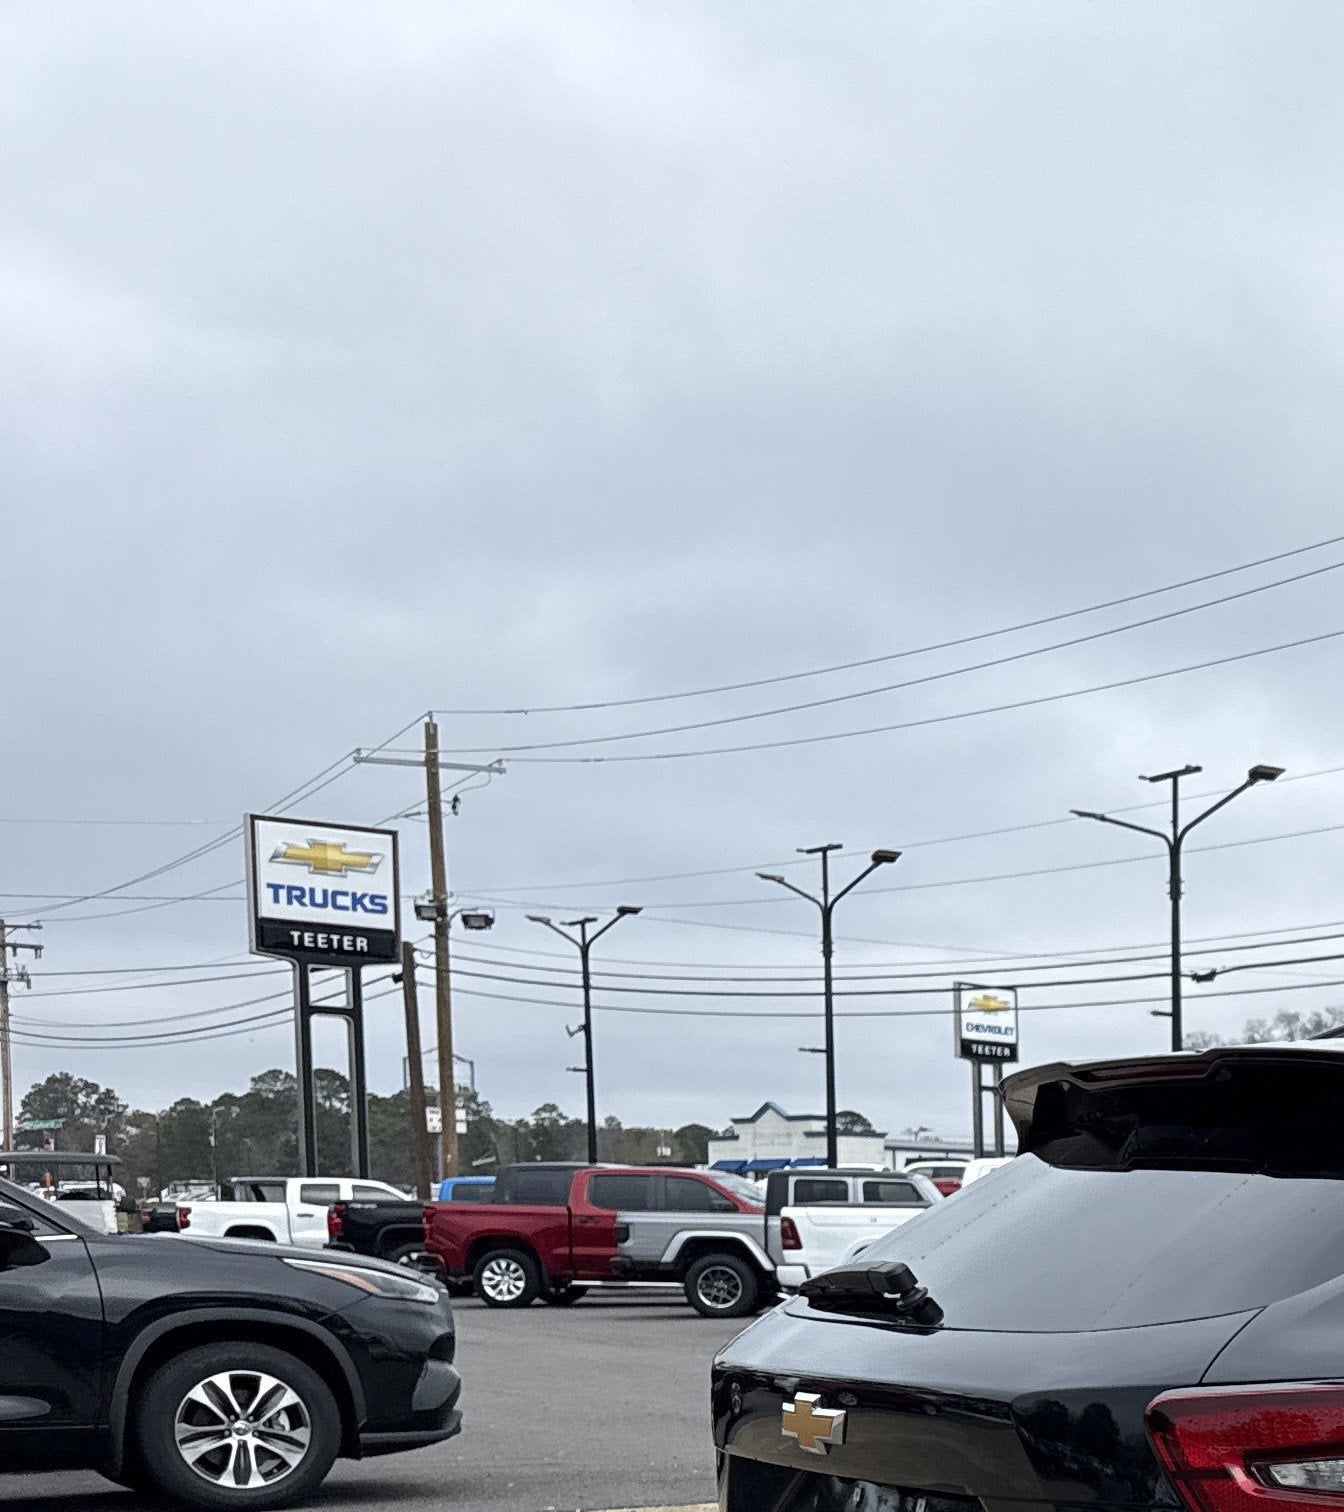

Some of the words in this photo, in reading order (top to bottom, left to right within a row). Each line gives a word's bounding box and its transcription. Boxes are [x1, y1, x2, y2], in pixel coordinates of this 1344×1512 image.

[267, 882, 388, 915] TRUCKS
[290, 930, 369, 953] TEETER
[966, 1022, 1014, 1036] CHEVROLET
[971, 1044, 1011, 1057] TEETER
